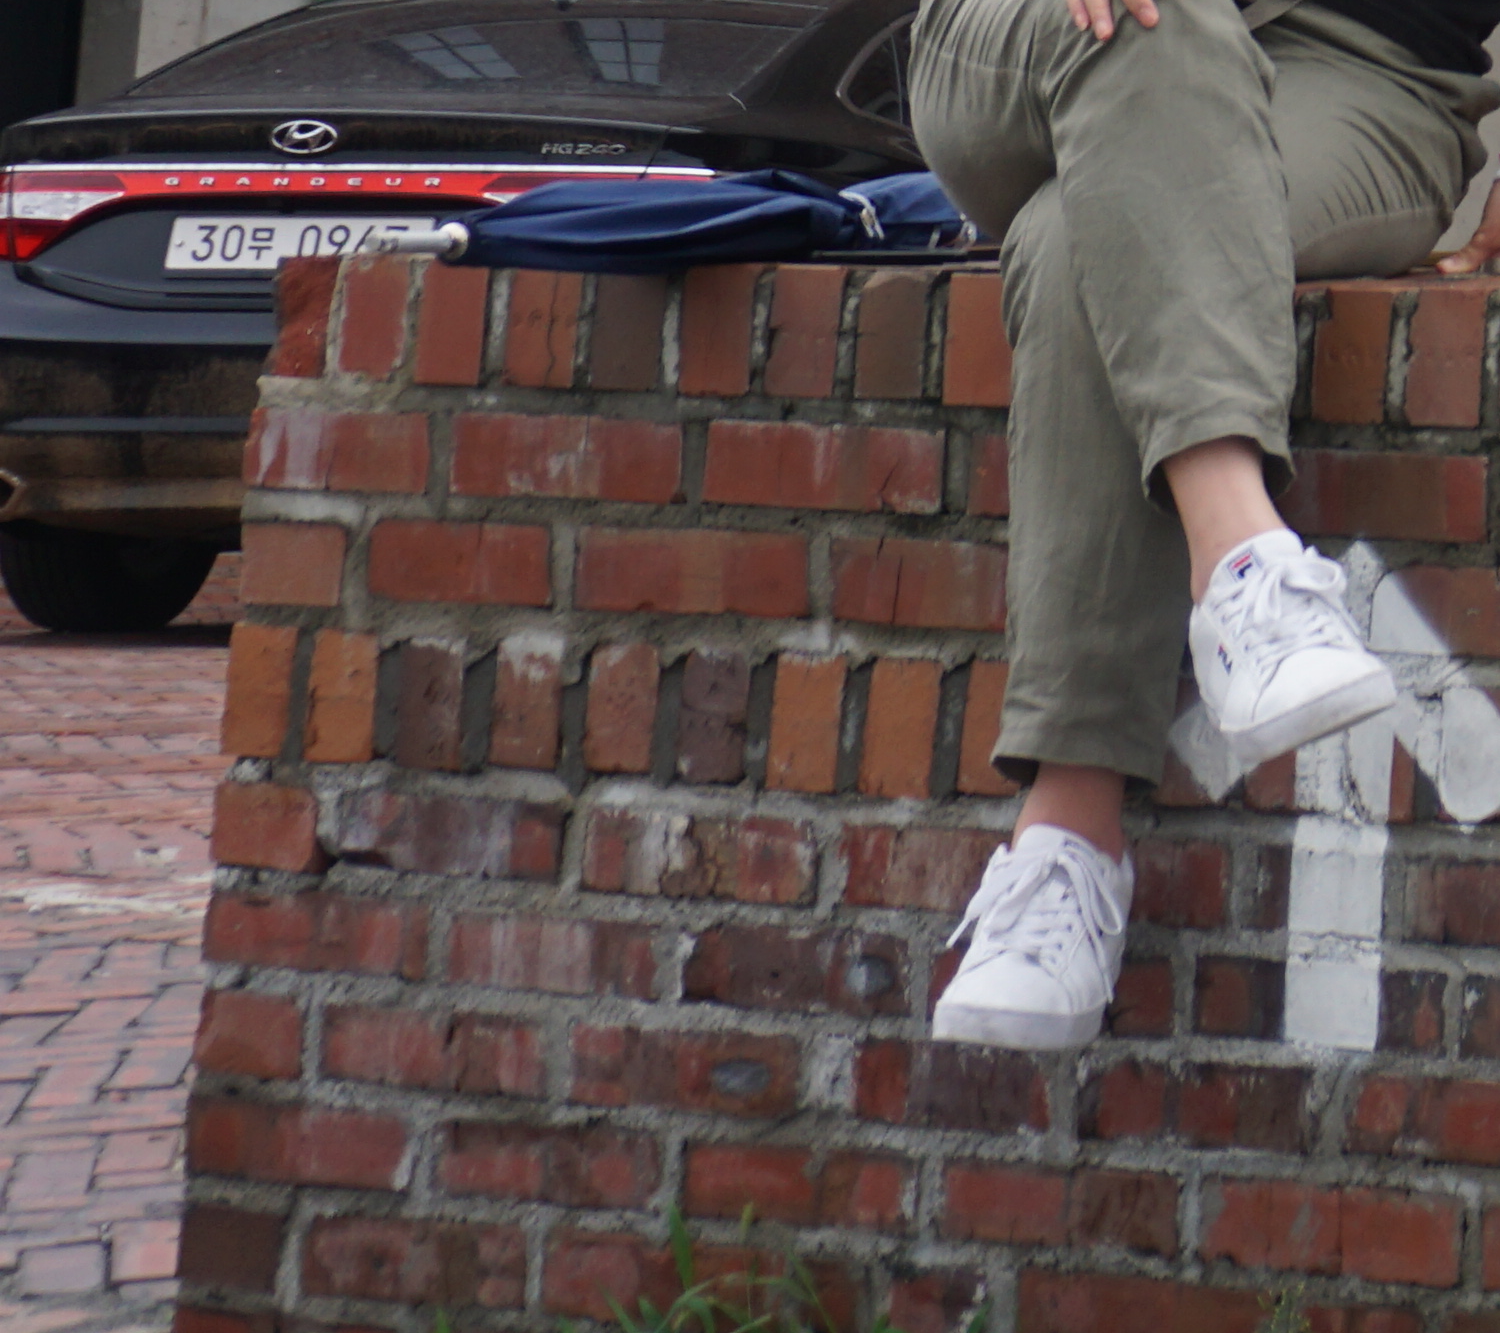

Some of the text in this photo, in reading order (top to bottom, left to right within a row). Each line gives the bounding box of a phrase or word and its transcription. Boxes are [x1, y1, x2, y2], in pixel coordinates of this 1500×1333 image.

[164, 176, 440, 187] GRANDEUR
[191, 224, 409, 261] 30무 09
